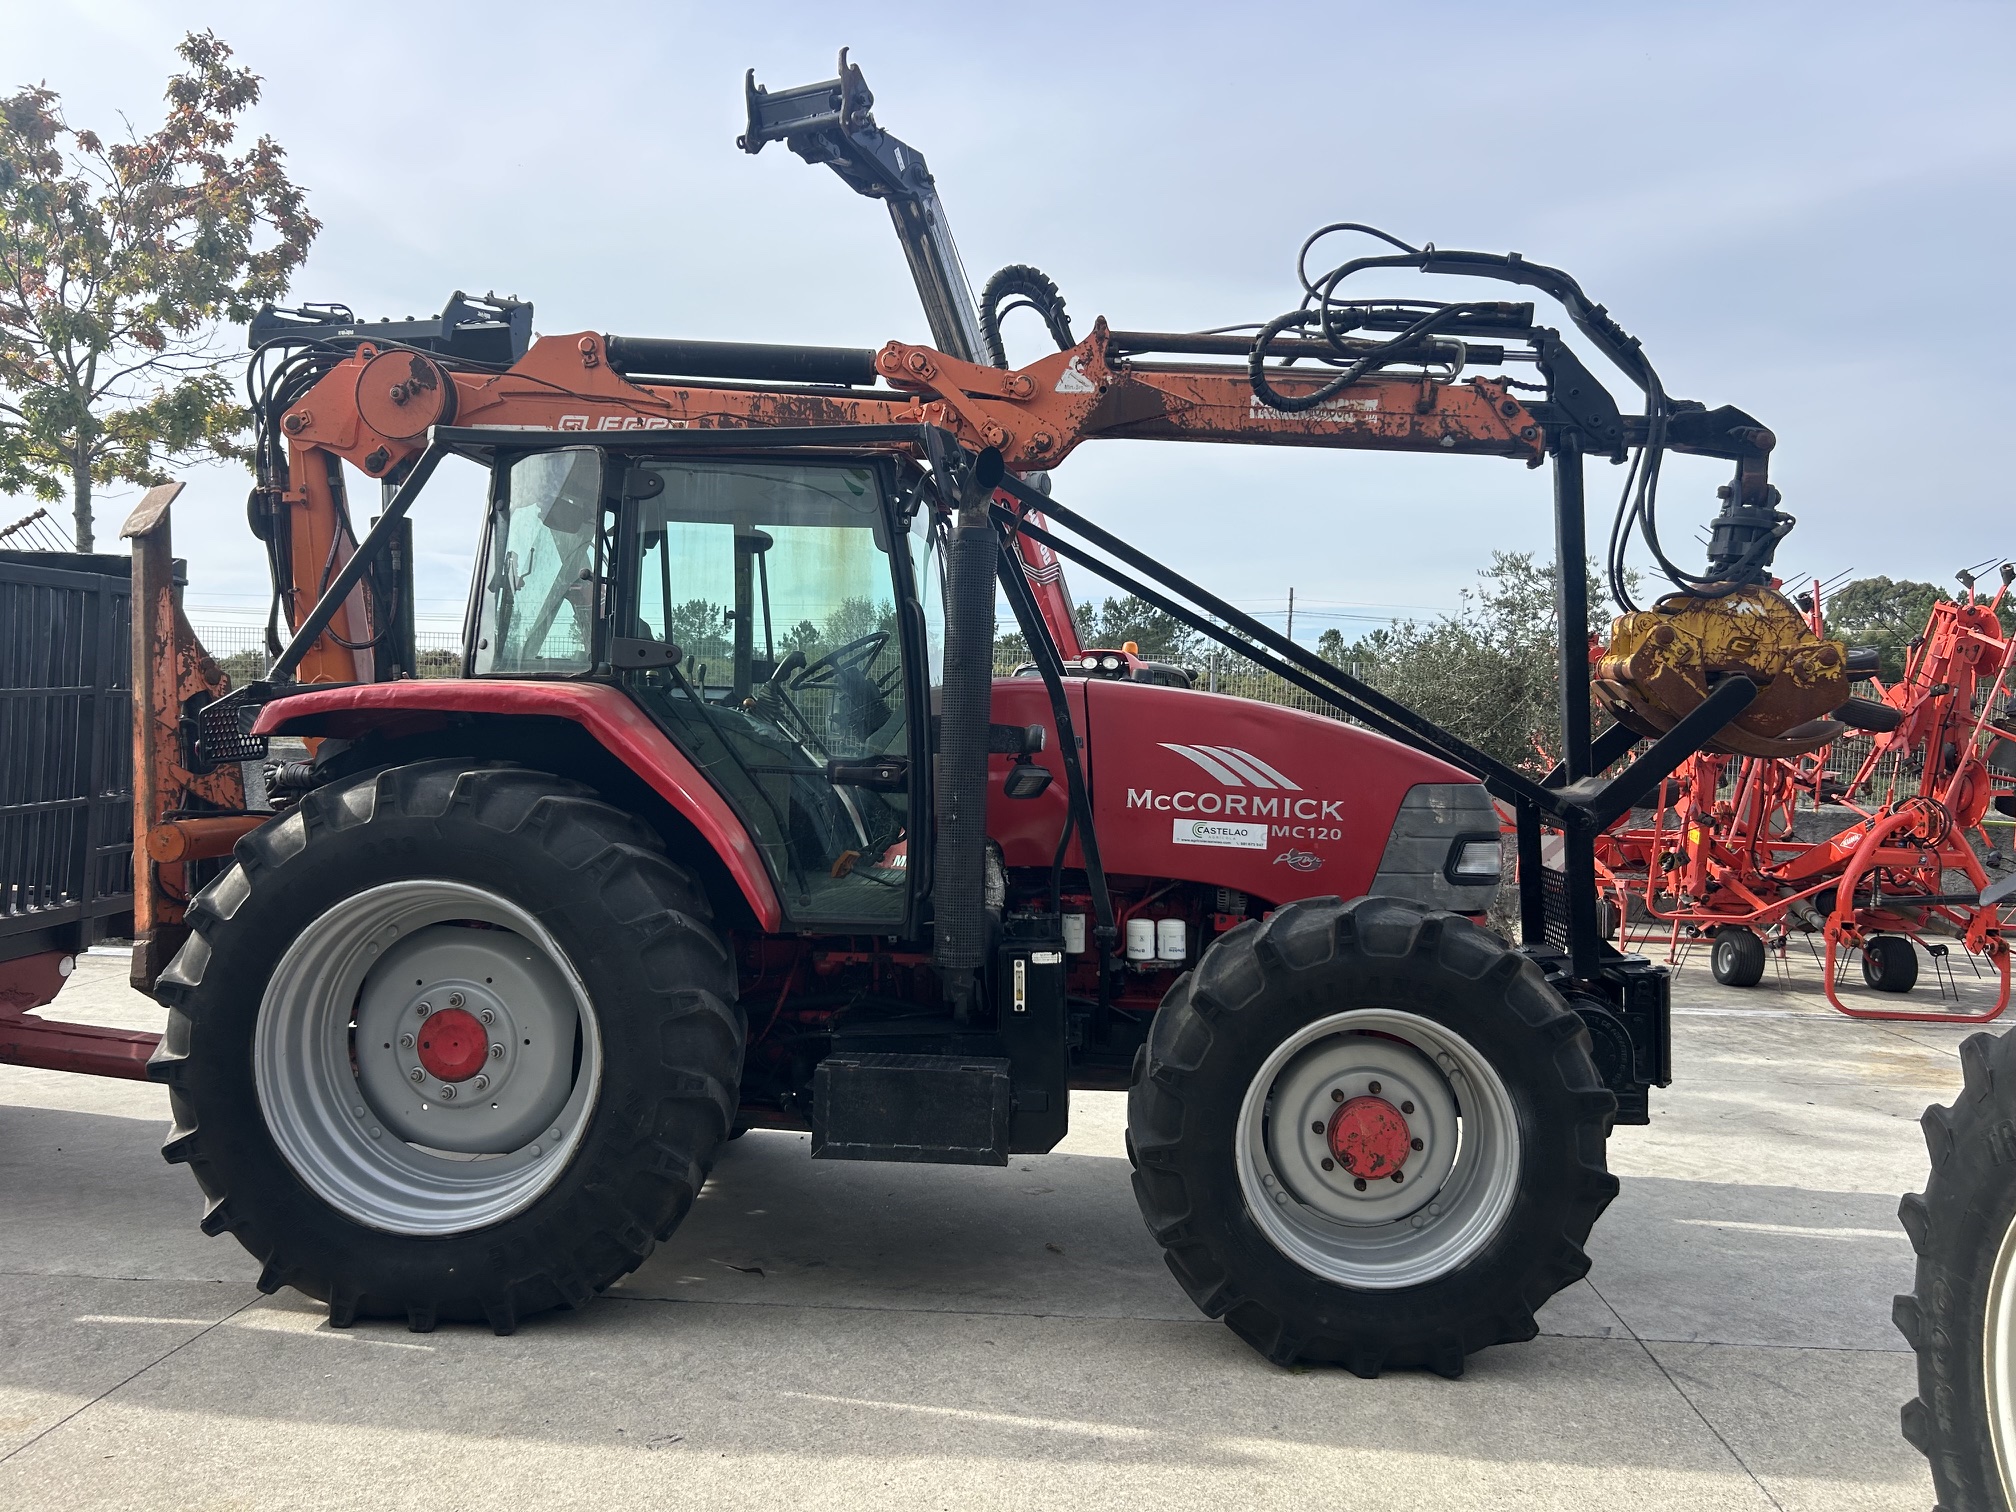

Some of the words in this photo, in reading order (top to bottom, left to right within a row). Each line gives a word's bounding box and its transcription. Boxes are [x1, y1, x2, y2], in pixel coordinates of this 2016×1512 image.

[1126, 788, 1345, 821] McCORMICK
[1196, 826, 1248, 836] CASTELAO
[1271, 825, 1342, 841] MC120
